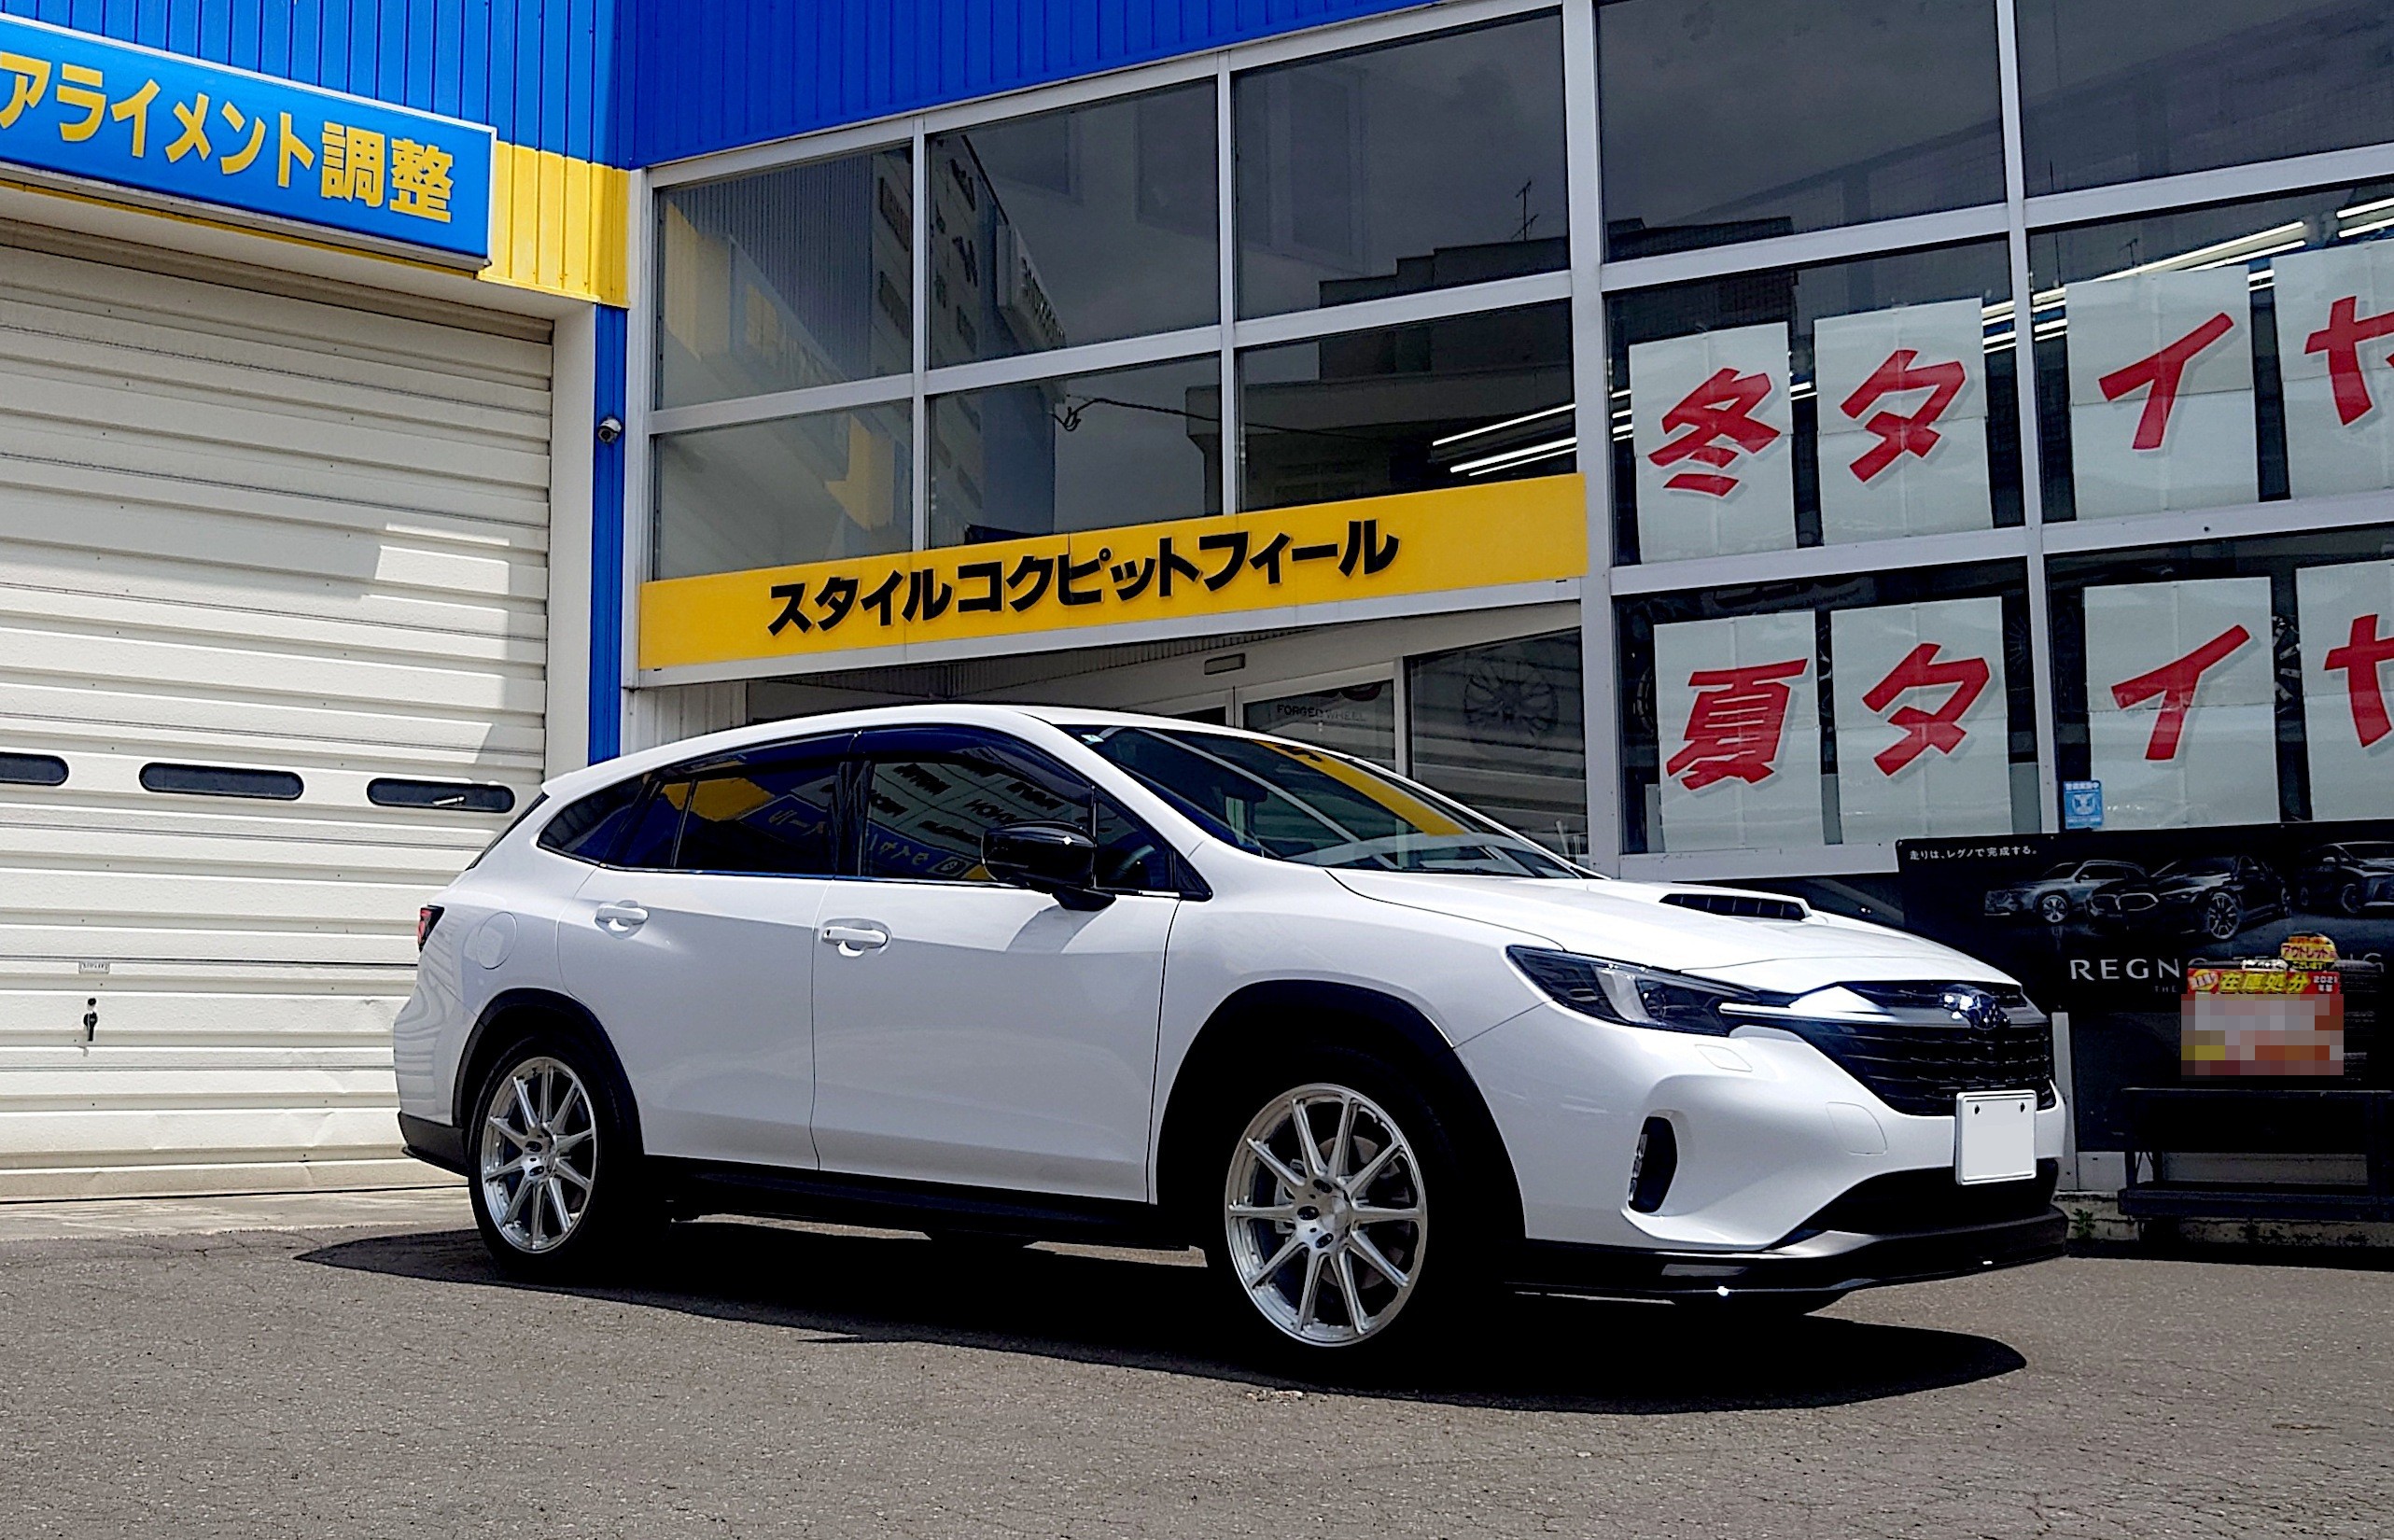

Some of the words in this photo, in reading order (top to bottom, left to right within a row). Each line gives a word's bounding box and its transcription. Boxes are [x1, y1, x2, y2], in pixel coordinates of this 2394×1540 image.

[0, 51, 454, 224] アライメント調整
[767, 519, 1400, 637] スタイルコクピットフィール
[1277, 704, 1323, 718] FORGED
[1910, 846, 2037, 861] 走りは、レグノで完成する。
[2220, 972, 2310, 993] 在庫処分
[2314, 975, 2338, 984] 2021
[2154, 985, 2177, 993] THE
